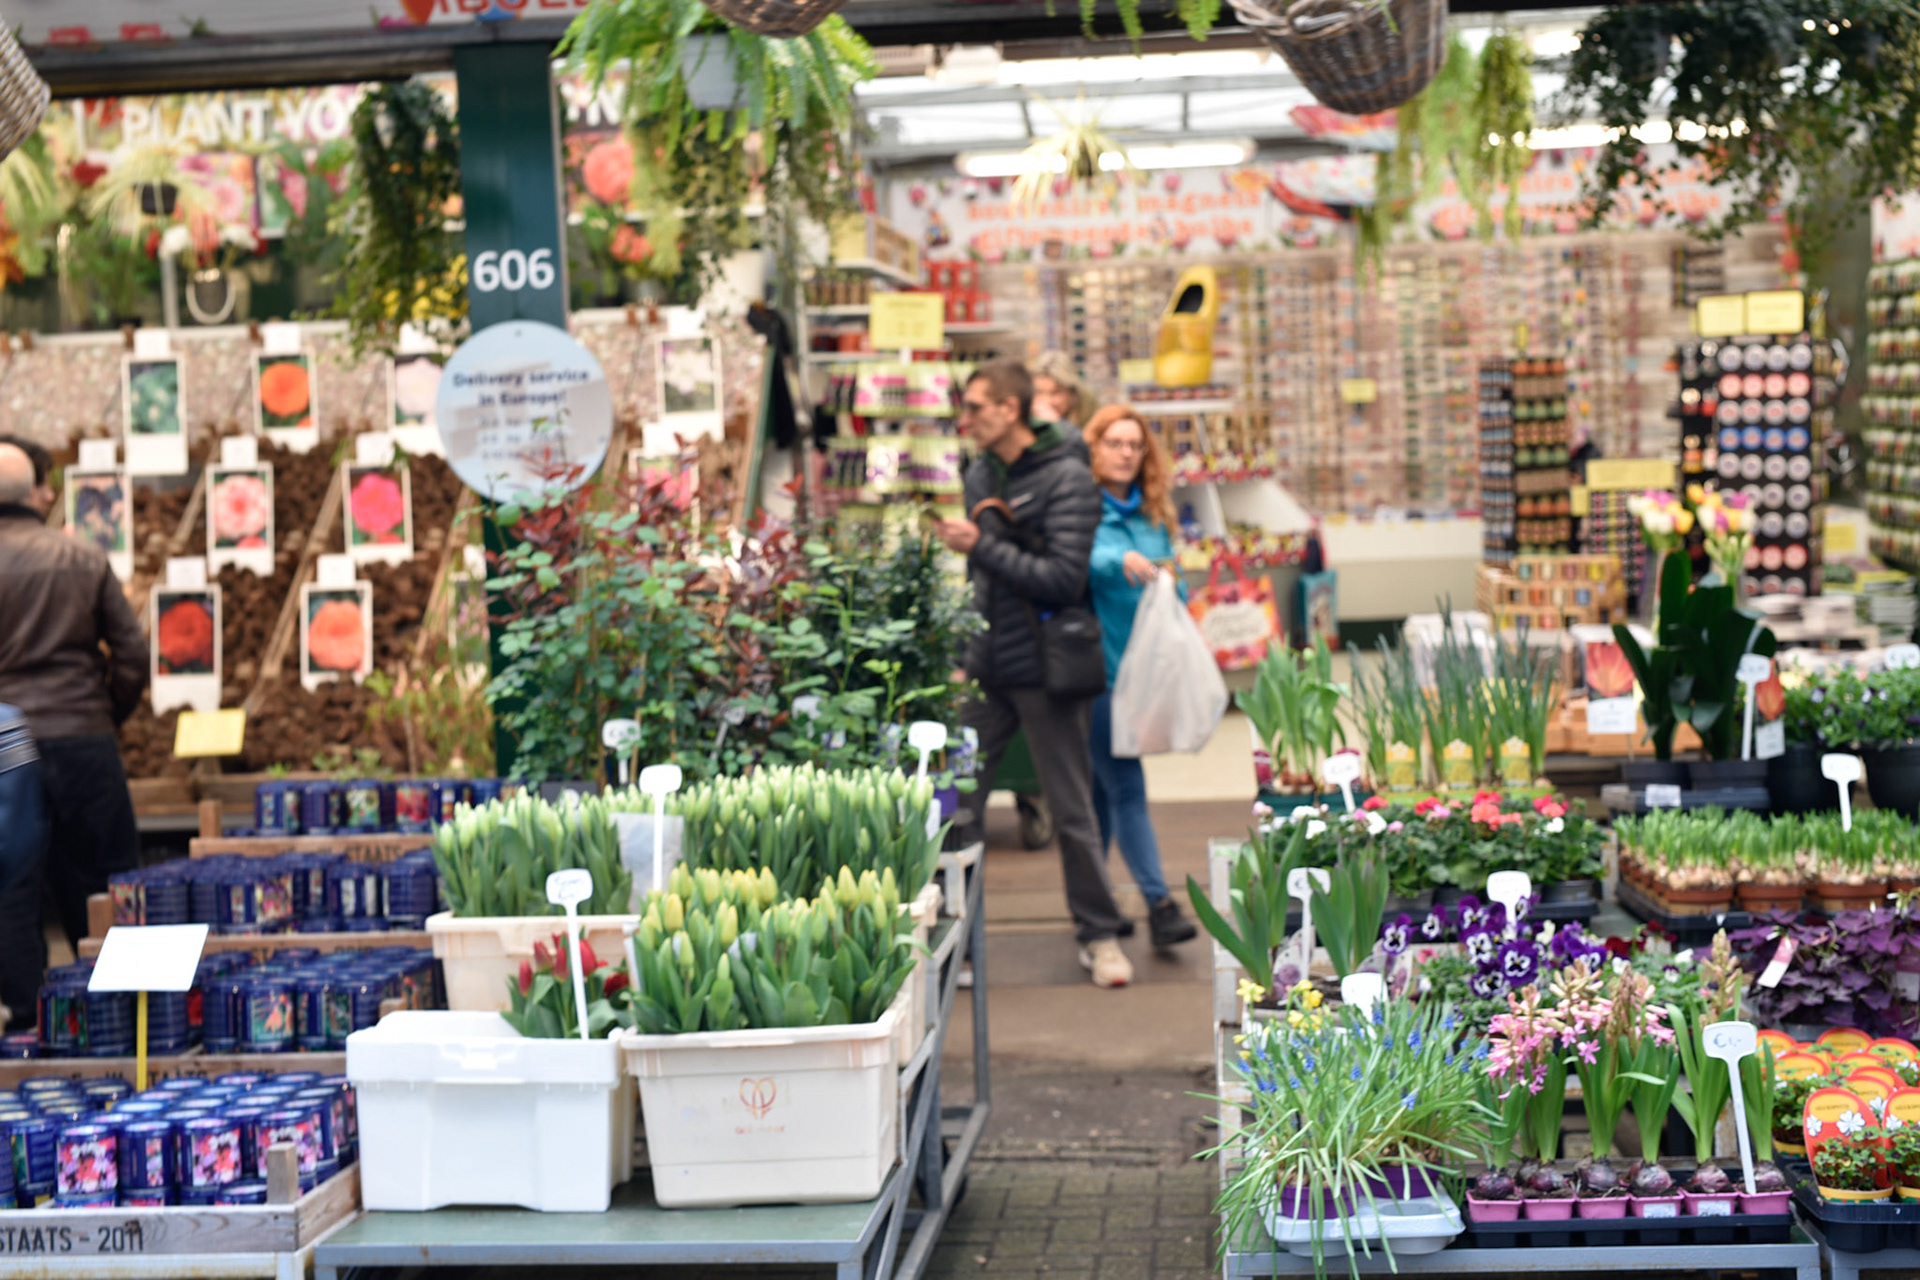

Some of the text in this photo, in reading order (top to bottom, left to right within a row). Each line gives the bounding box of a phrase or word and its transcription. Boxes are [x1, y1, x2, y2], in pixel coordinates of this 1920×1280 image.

[121, 95, 274, 148] PLANT
[274, 93, 361, 141] YO
[473, 247, 556, 292] 606
[453, 369, 589, 388] Delivery service
[478, 392, 496, 406] in
[97, 1225, 144, 1252] 2011
